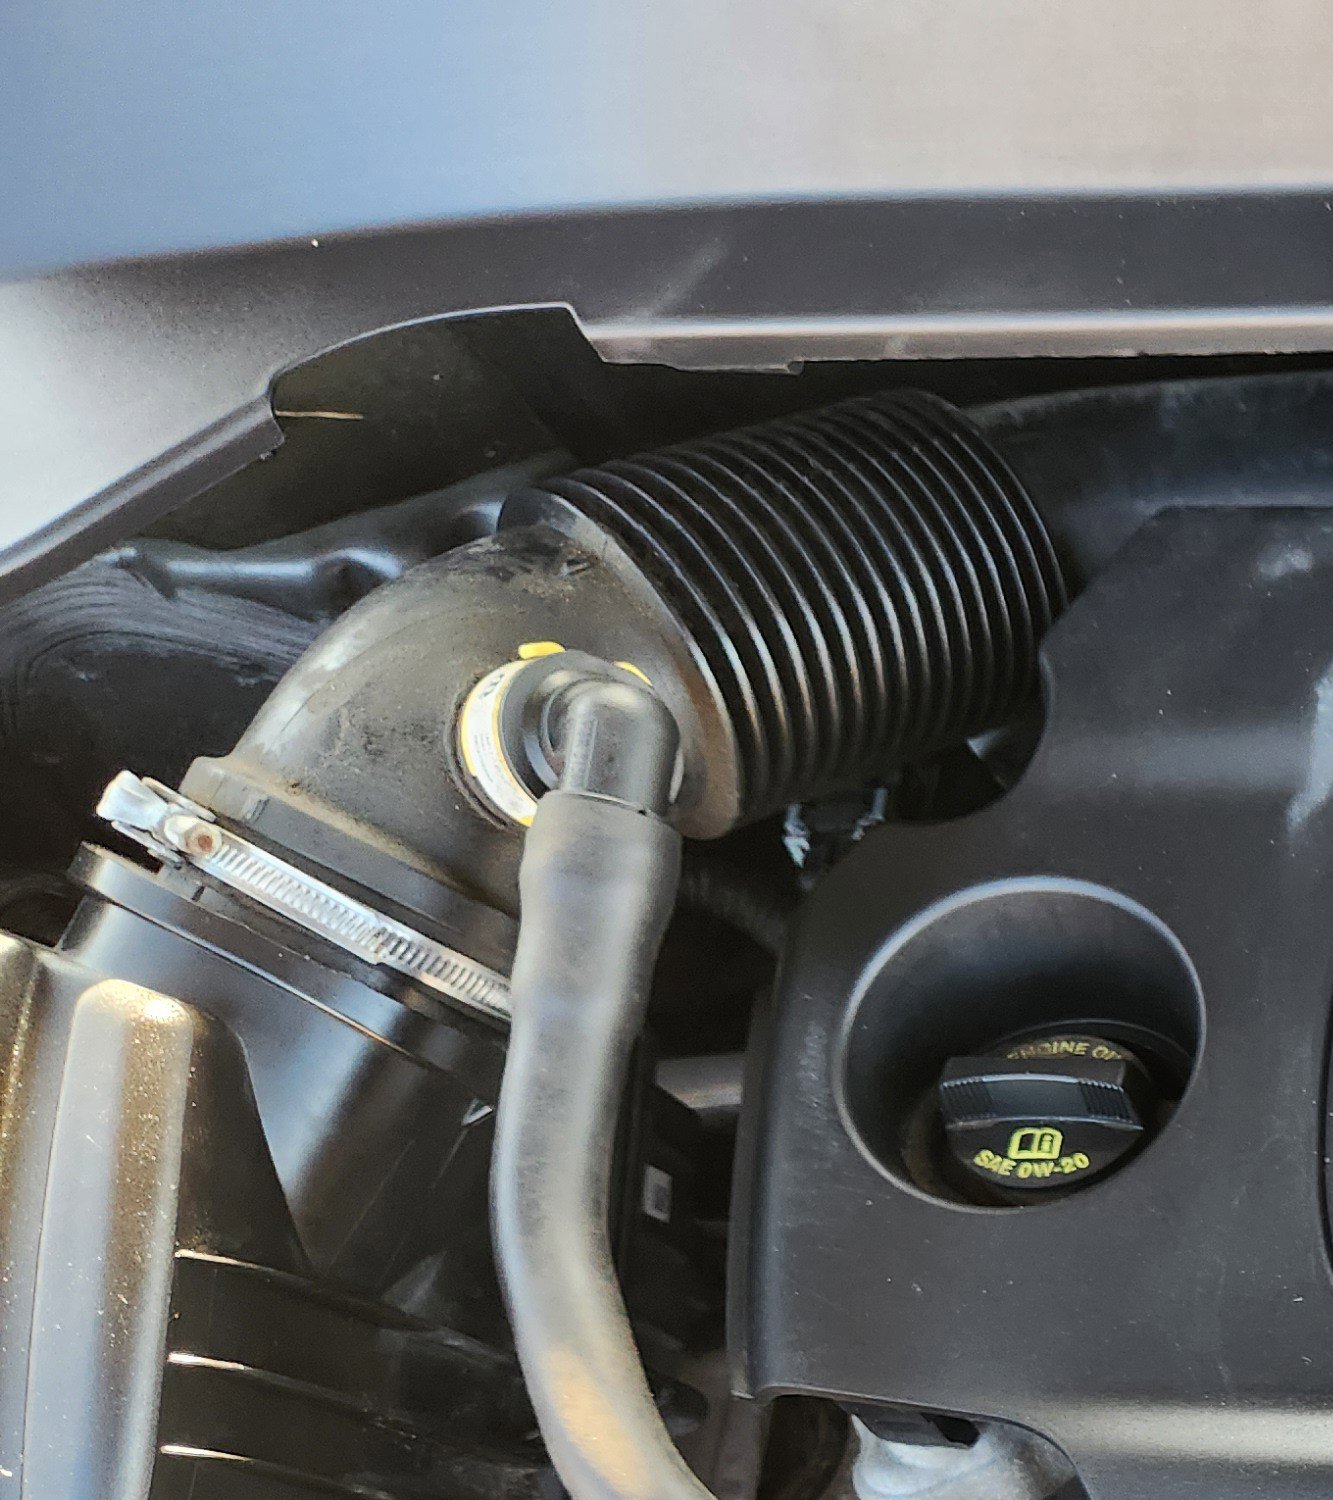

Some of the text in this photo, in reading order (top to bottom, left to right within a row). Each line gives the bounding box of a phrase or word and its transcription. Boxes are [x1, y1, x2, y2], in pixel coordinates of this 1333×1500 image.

[1092, 1045, 1122, 1060] OI
[973, 1149, 1089, 1178] SAE 0W-20
